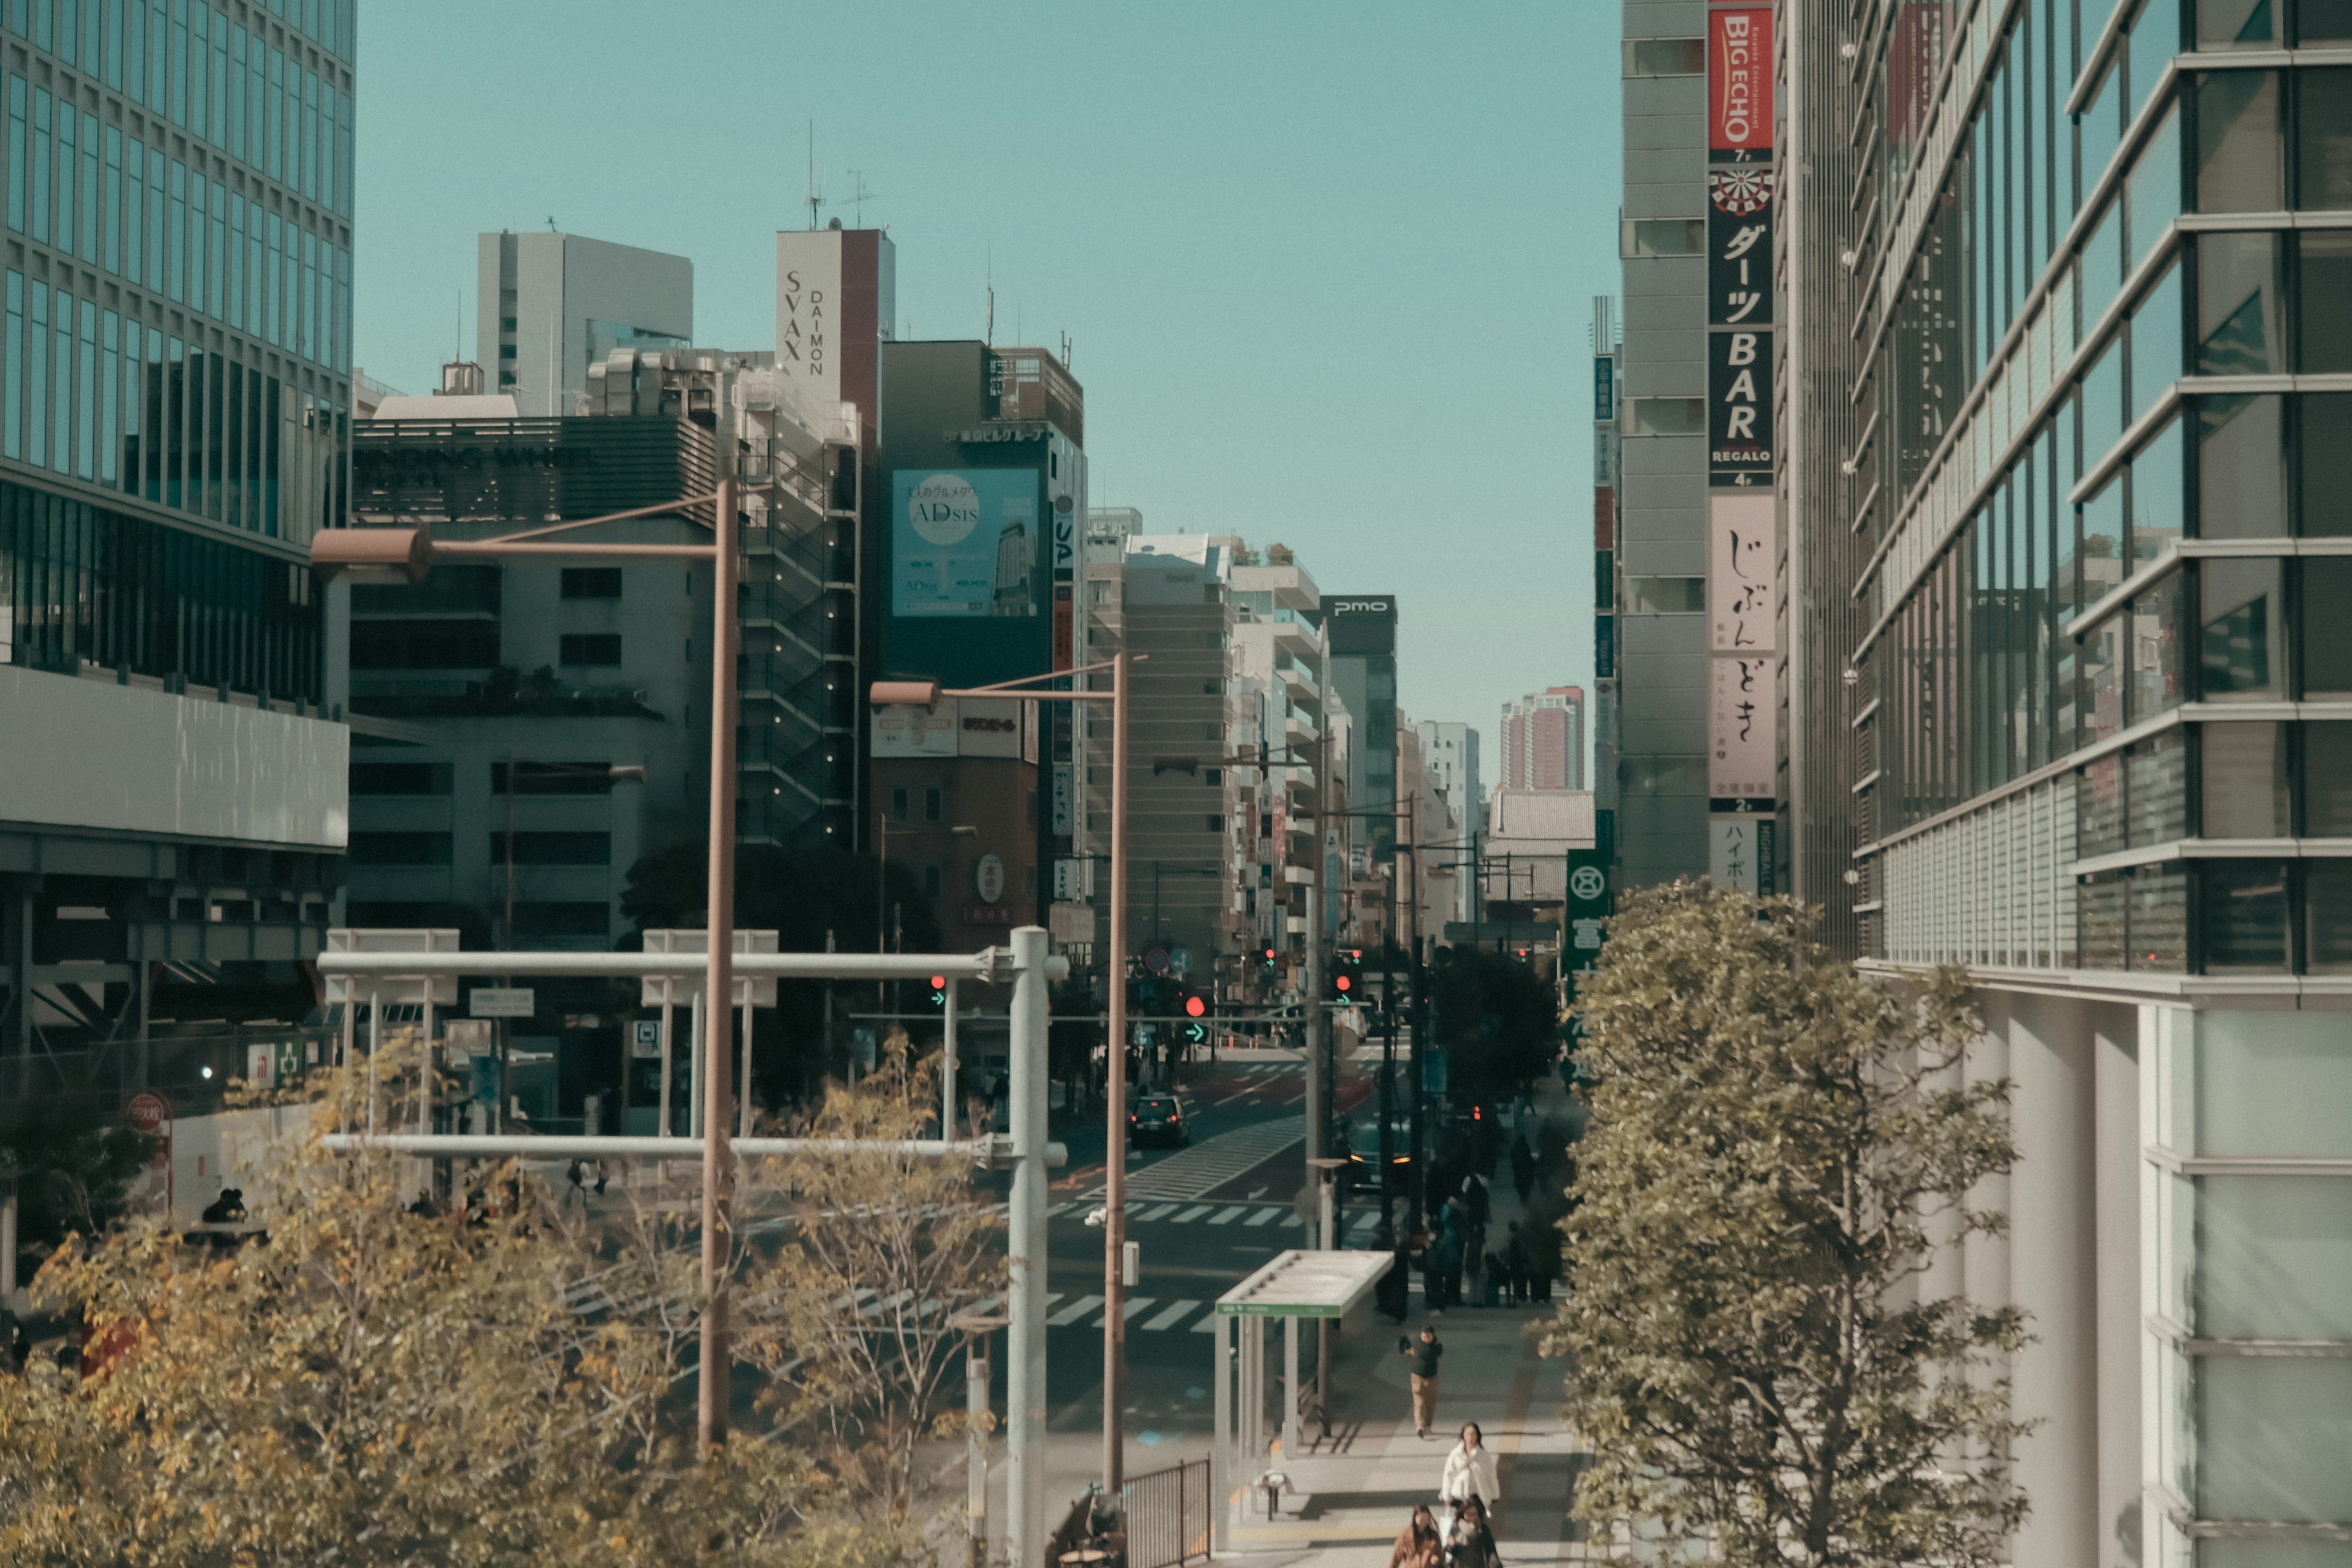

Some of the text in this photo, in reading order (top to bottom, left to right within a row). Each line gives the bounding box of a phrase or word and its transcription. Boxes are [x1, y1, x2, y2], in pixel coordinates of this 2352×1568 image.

[1724, 16, 1749, 142] BIG ECHO
[1735, 149, 1752, 163] 7F
[1724, 224, 1766, 323] ダーツ
[785, 270, 801, 361] SVAX
[810, 290, 823, 375] DAIMON
[1725, 333, 1757, 439] BAR
[1712, 450, 1770, 462] REGALO
[1734, 472, 1753, 486] 4F
[913, 502, 978, 522] ADsis
[1055, 521, 1072, 564] UP
[1335, 600, 1387, 616] pmo
[1728, 530, 1766, 743] じぶんどき
[1736, 799, 1752, 812] 2F
[1760, 826, 1772, 883] HIGHBALL
